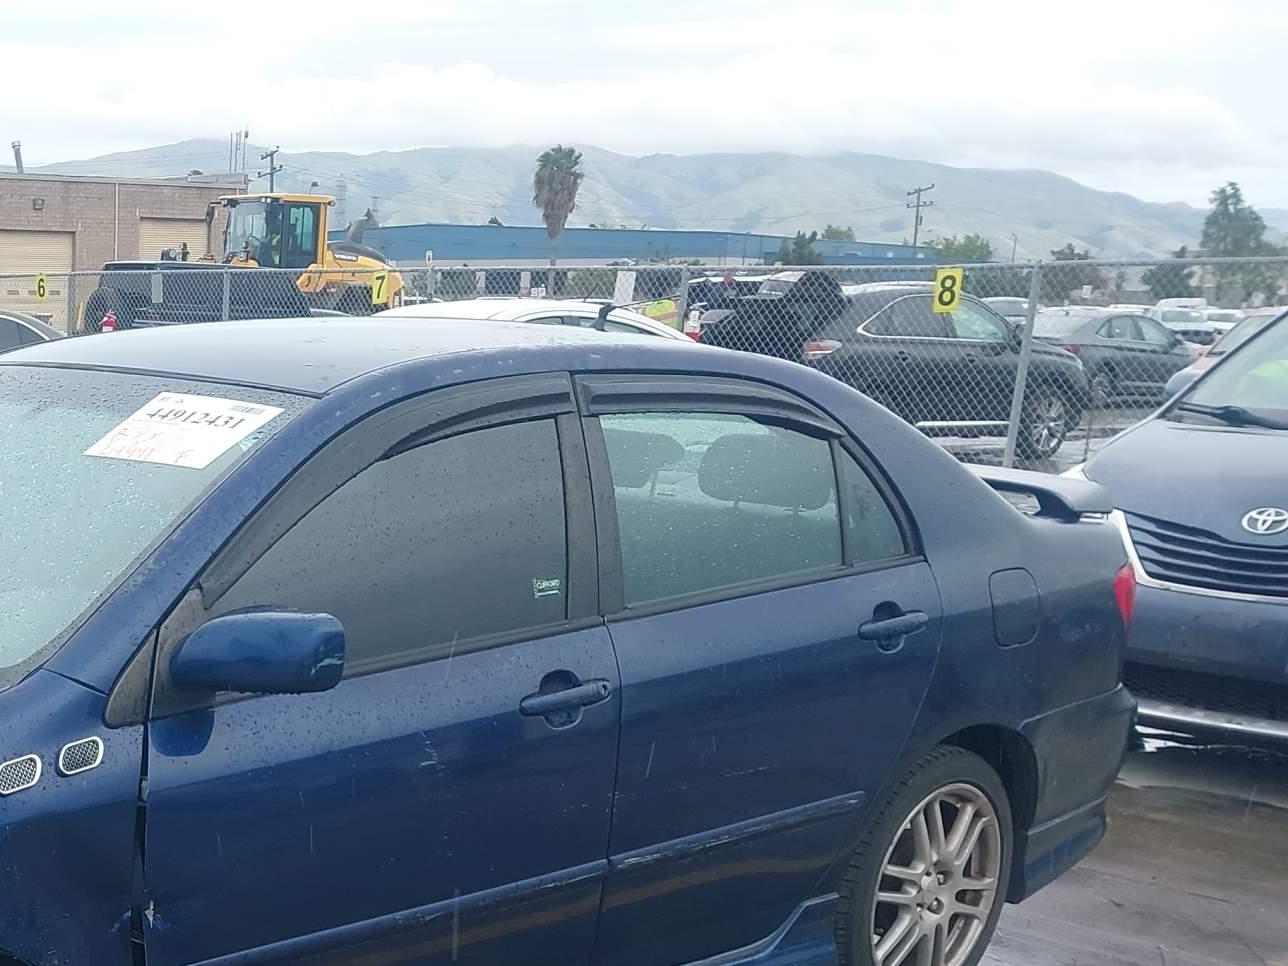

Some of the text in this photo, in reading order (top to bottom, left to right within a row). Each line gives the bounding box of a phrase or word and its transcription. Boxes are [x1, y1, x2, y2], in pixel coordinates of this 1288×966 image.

[37, 278, 46, 298] 6
[375, 274, 386, 299] 7
[938, 275, 957, 306] 8
[146, 407, 246, 429] 44912431
